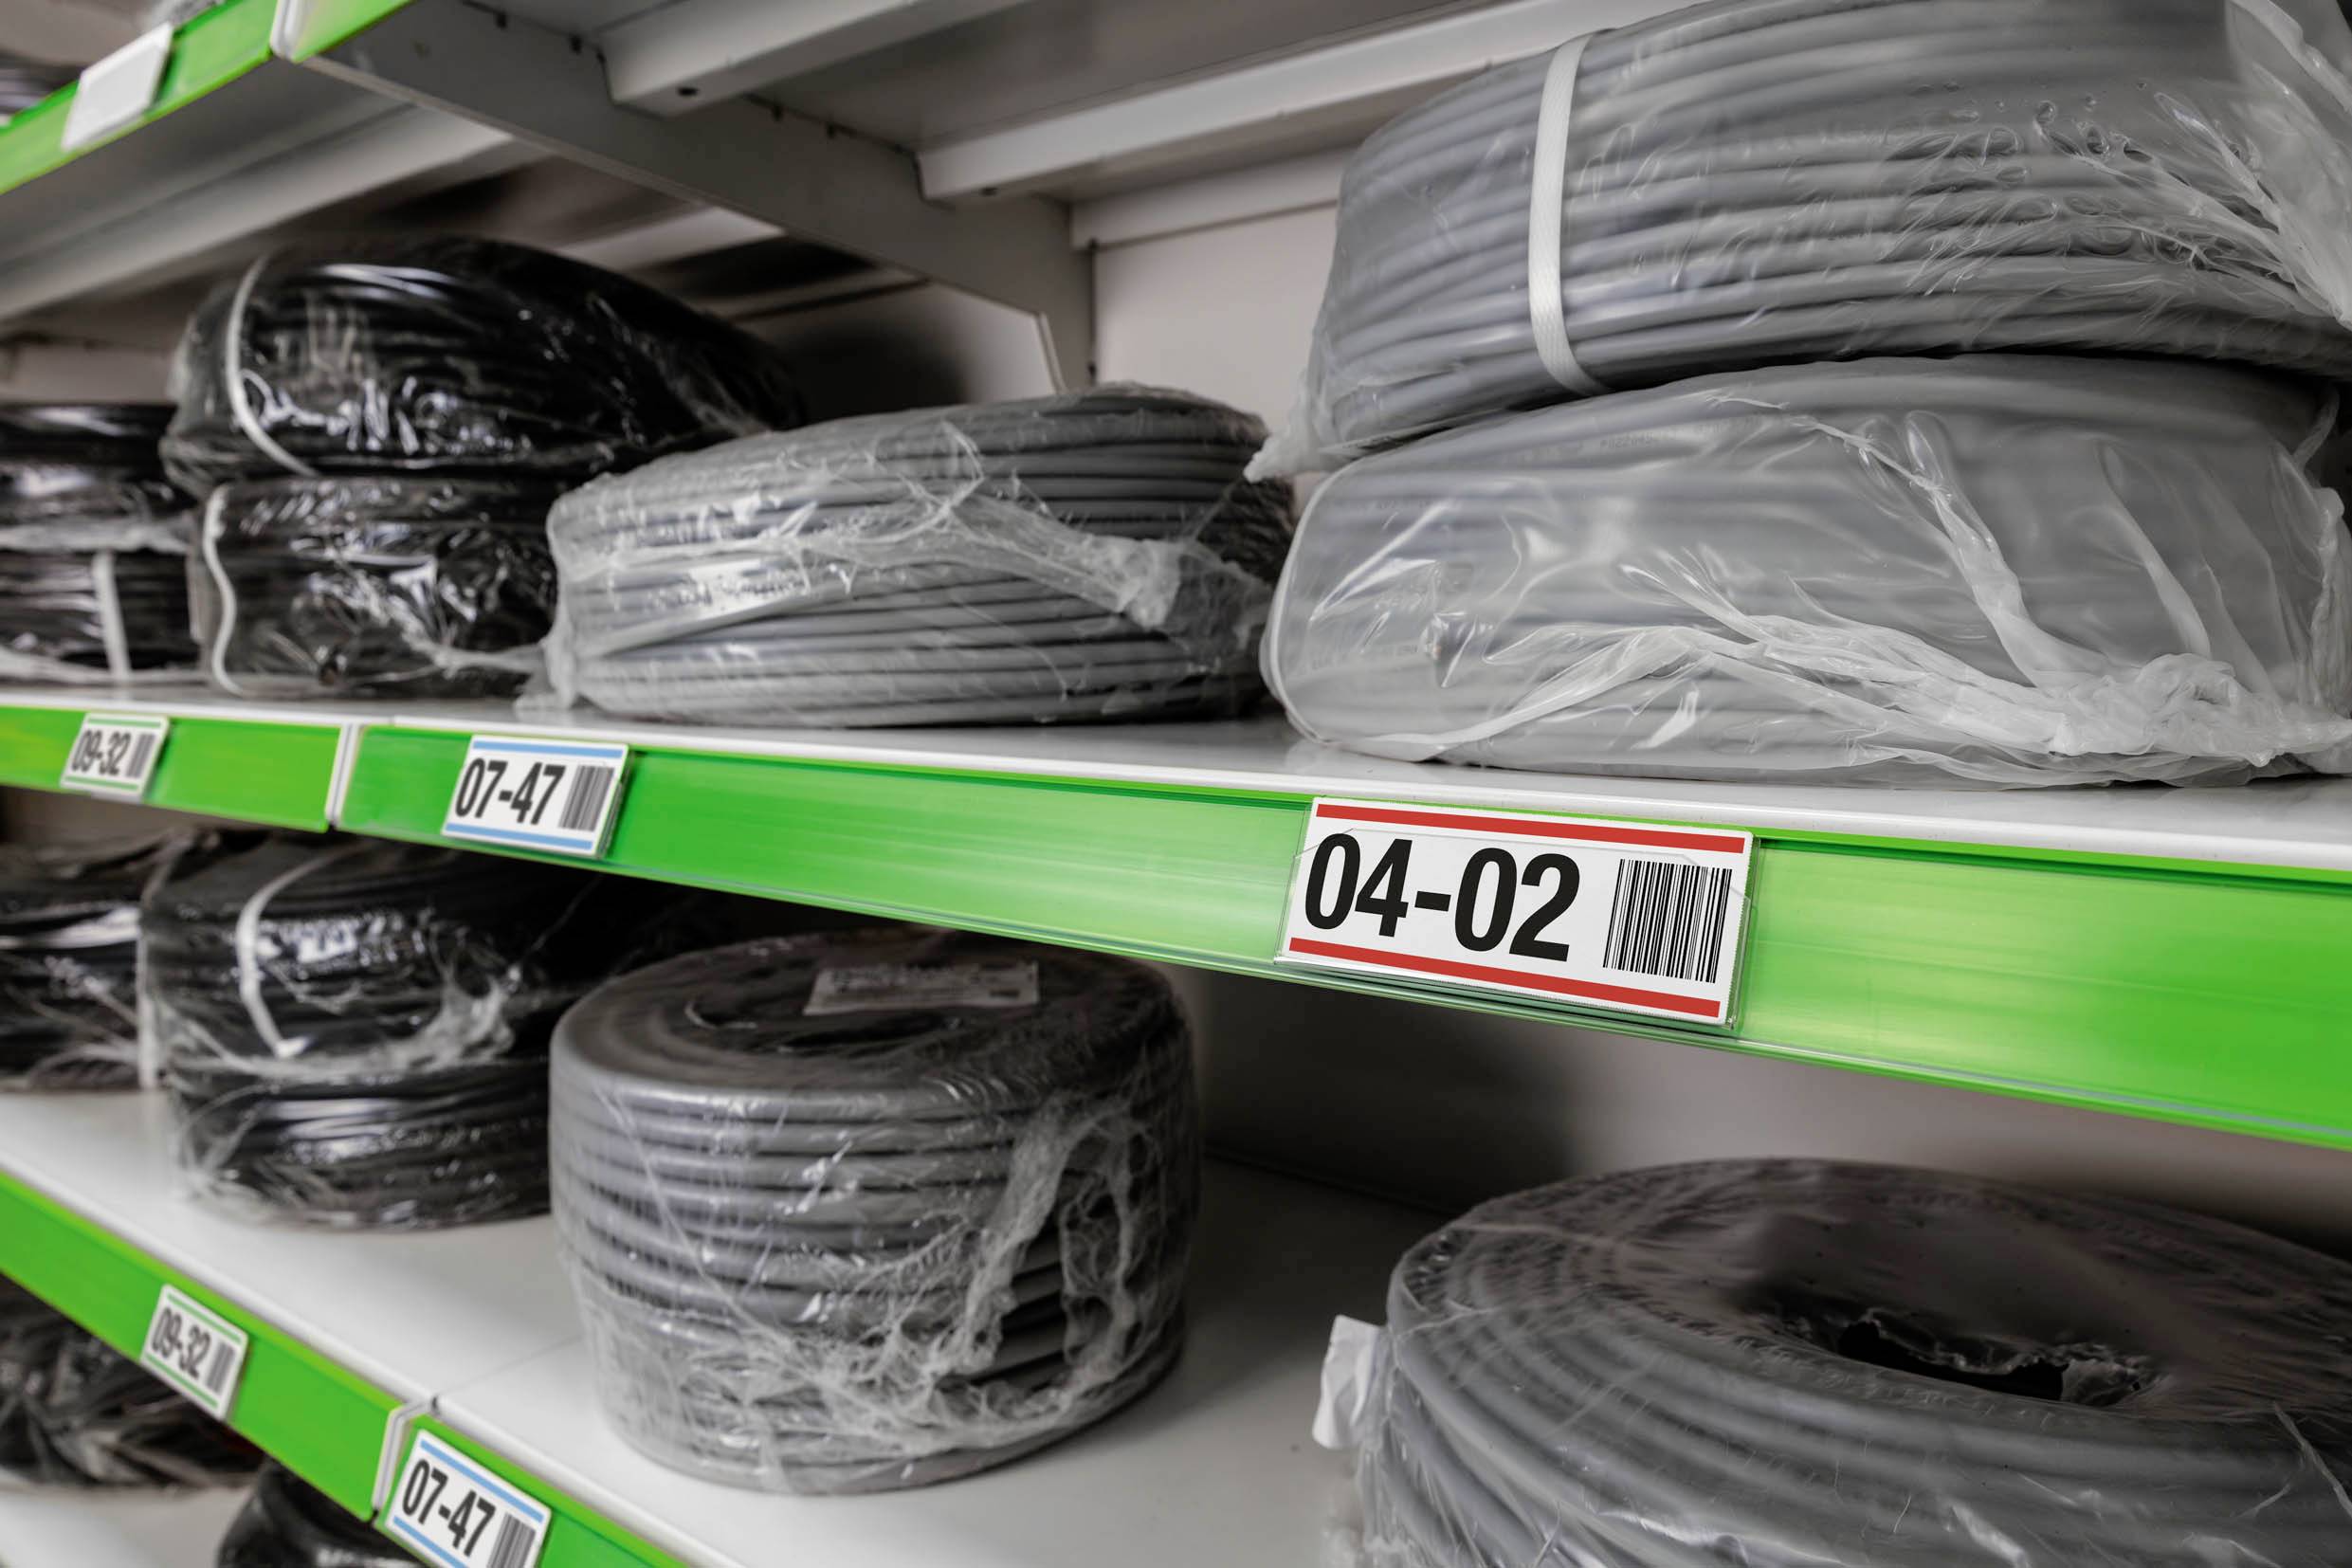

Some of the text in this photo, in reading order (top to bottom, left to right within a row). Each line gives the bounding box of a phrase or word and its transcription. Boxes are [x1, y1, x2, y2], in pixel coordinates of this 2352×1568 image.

[71, 729, 132, 776] 09-32
[455, 757, 567, 825] 07-47
[1304, 832, 1581, 963] 04-02
[152, 1306, 211, 1381] 09-32
[402, 1459, 497, 1558] 07-47
